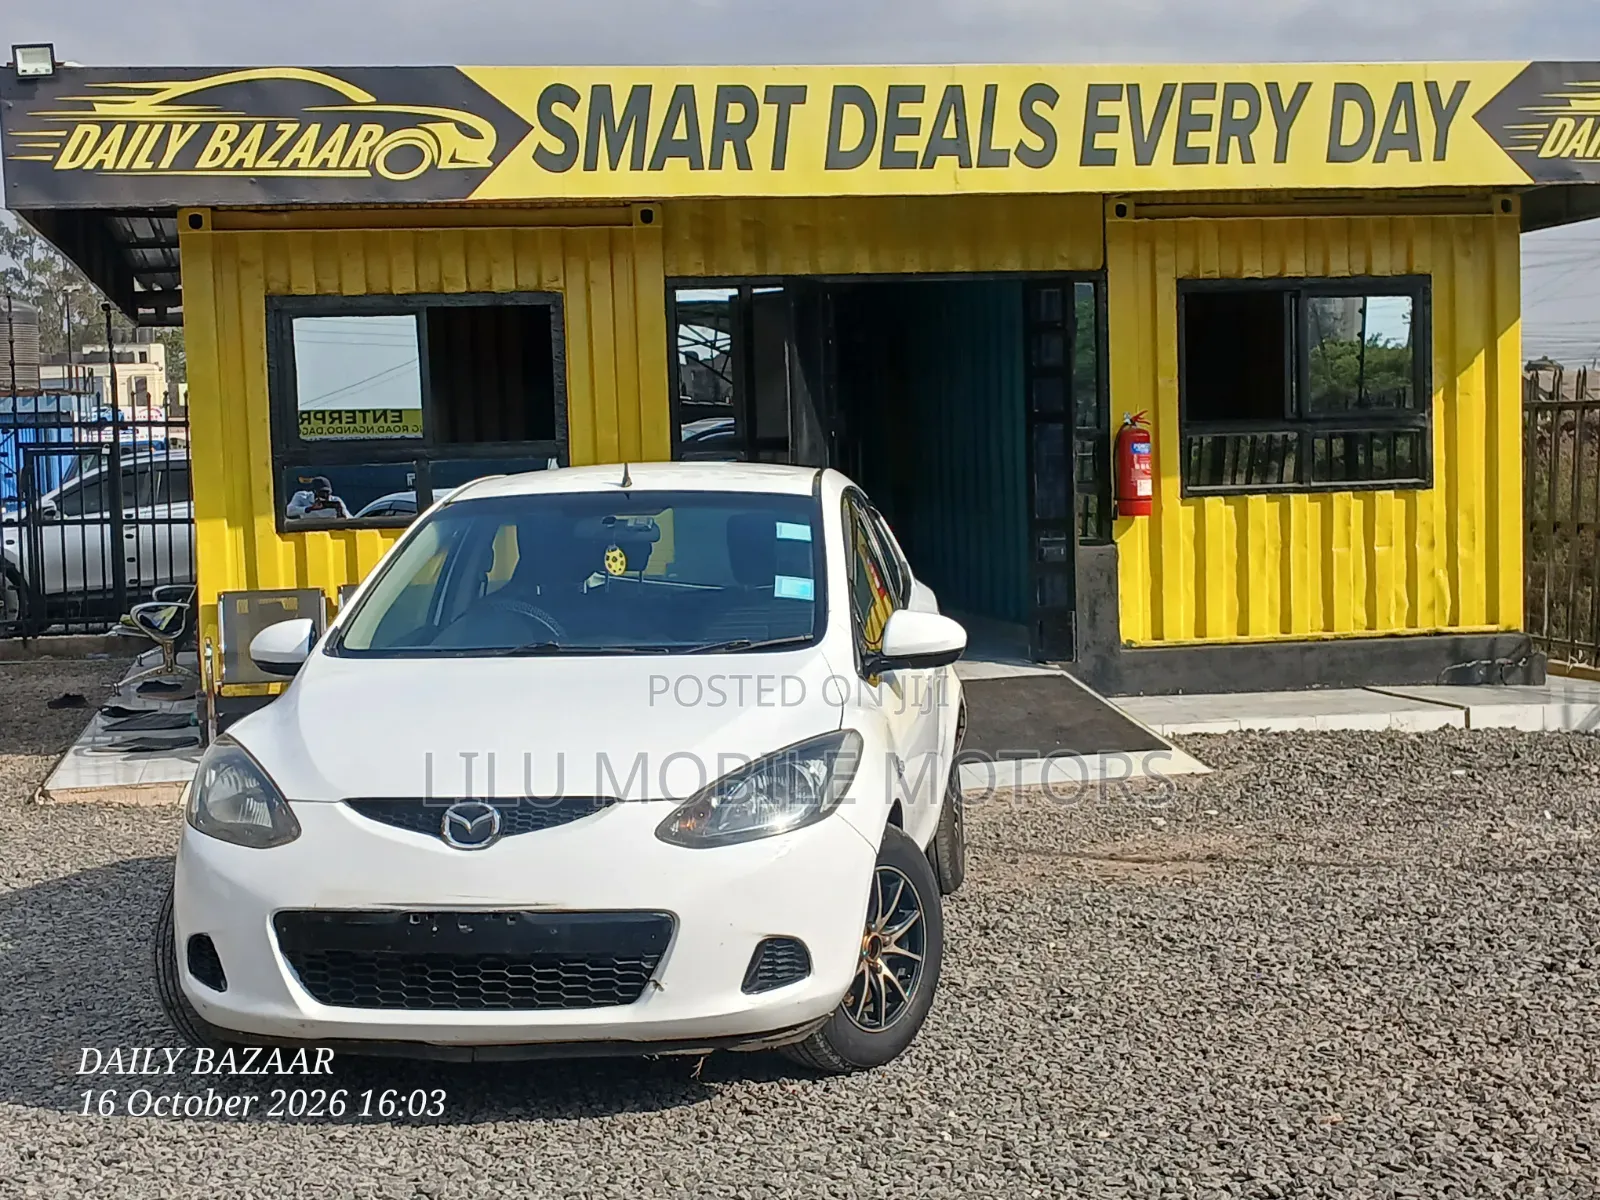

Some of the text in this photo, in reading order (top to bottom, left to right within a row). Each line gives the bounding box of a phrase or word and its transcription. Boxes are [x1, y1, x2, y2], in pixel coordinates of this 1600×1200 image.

[53, 122, 384, 170] DAILY BAZAAR
[532, 80, 1471, 173] SMART DEALS EVERY DAY
[1537, 117, 1600, 158] DAI
